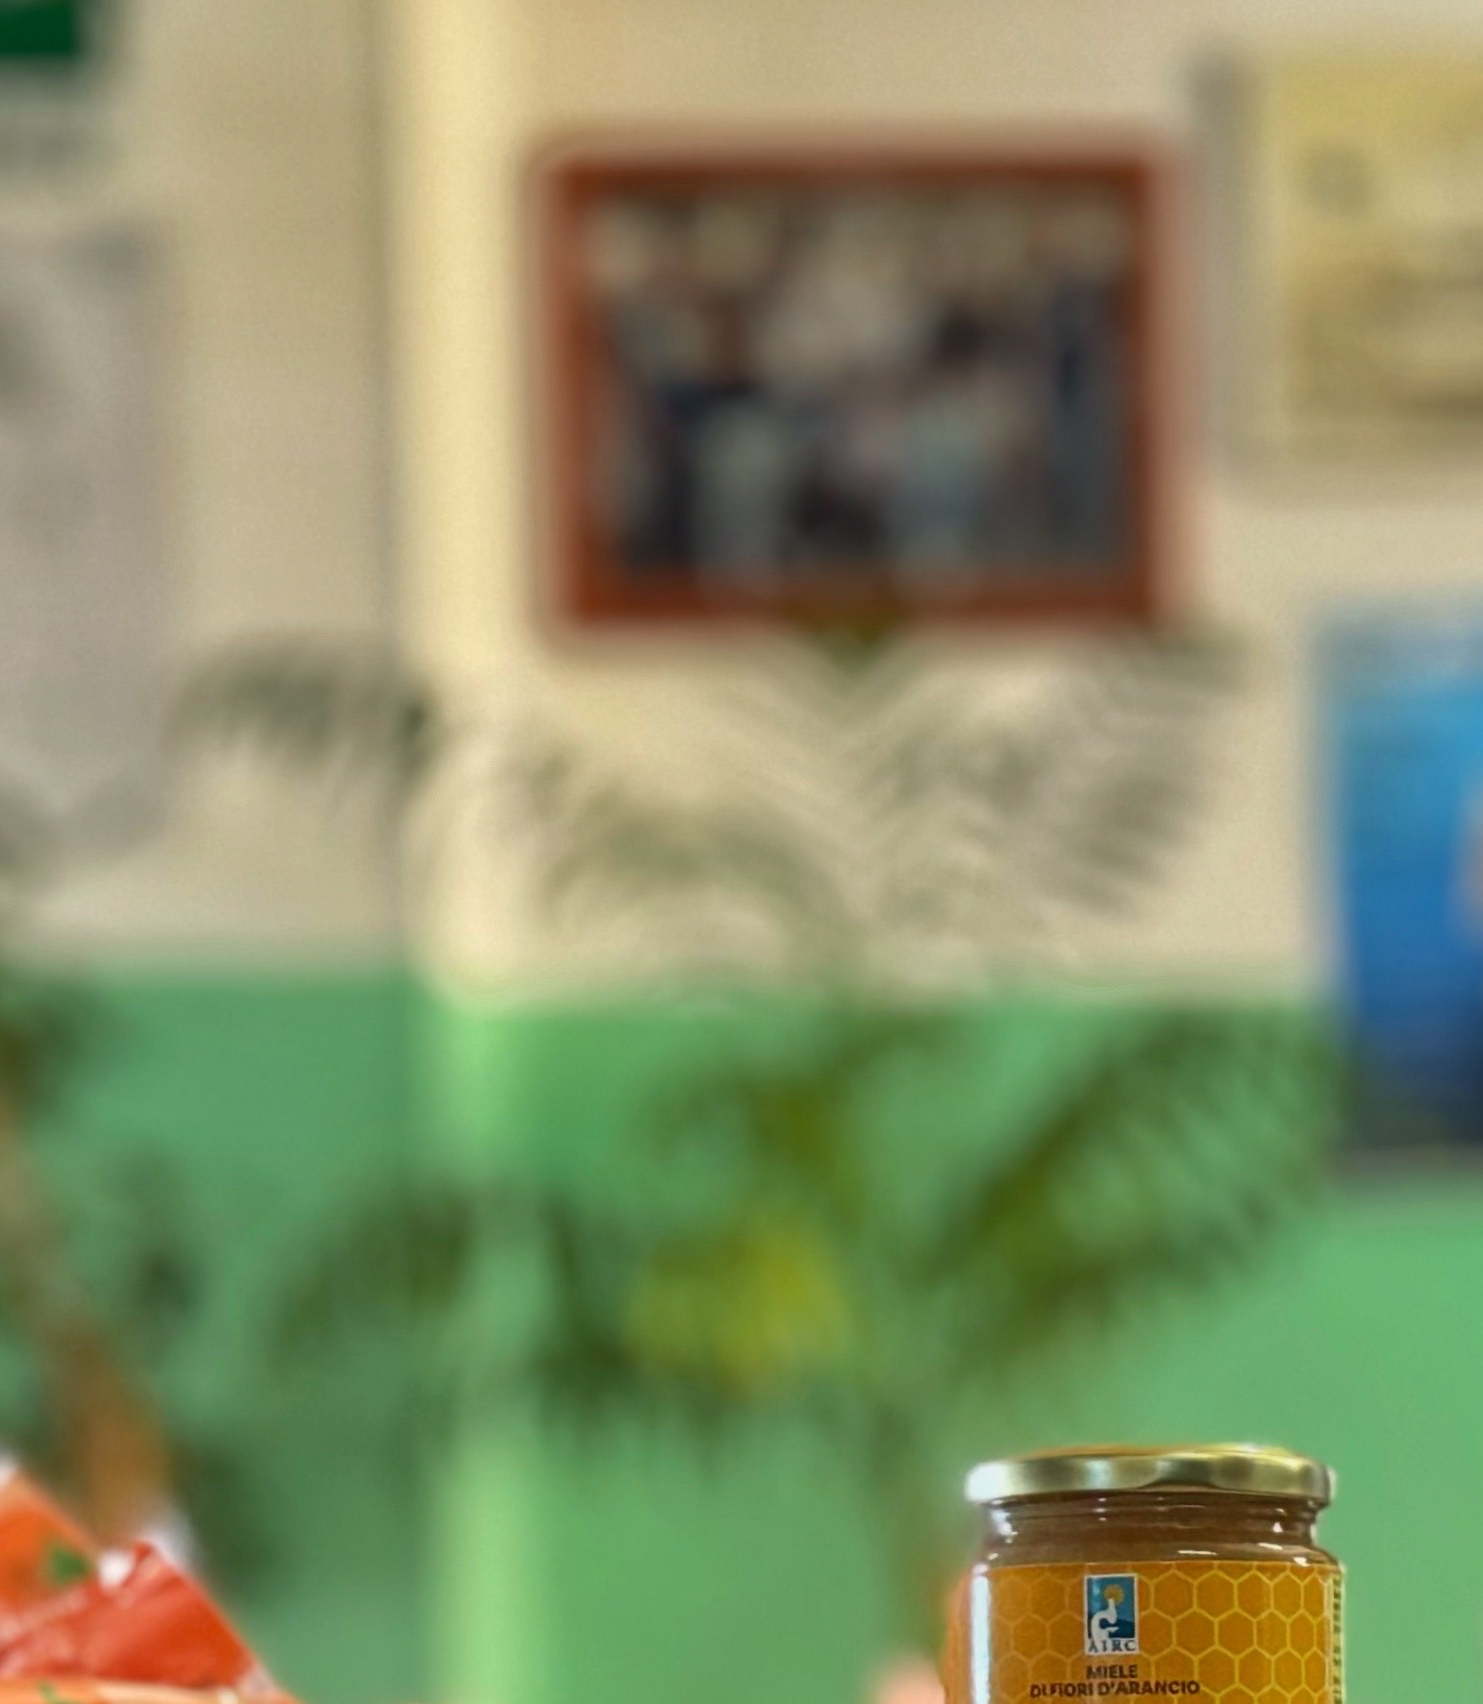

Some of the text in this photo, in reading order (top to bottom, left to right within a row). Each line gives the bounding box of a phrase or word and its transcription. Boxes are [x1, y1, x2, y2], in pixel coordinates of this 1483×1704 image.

[1088, 1639, 1136, 1653] AIRC
[1085, 1664, 1138, 1680] MIELE
[1029, 1680, 1201, 1698] DI FIORI D'ARANCIO
